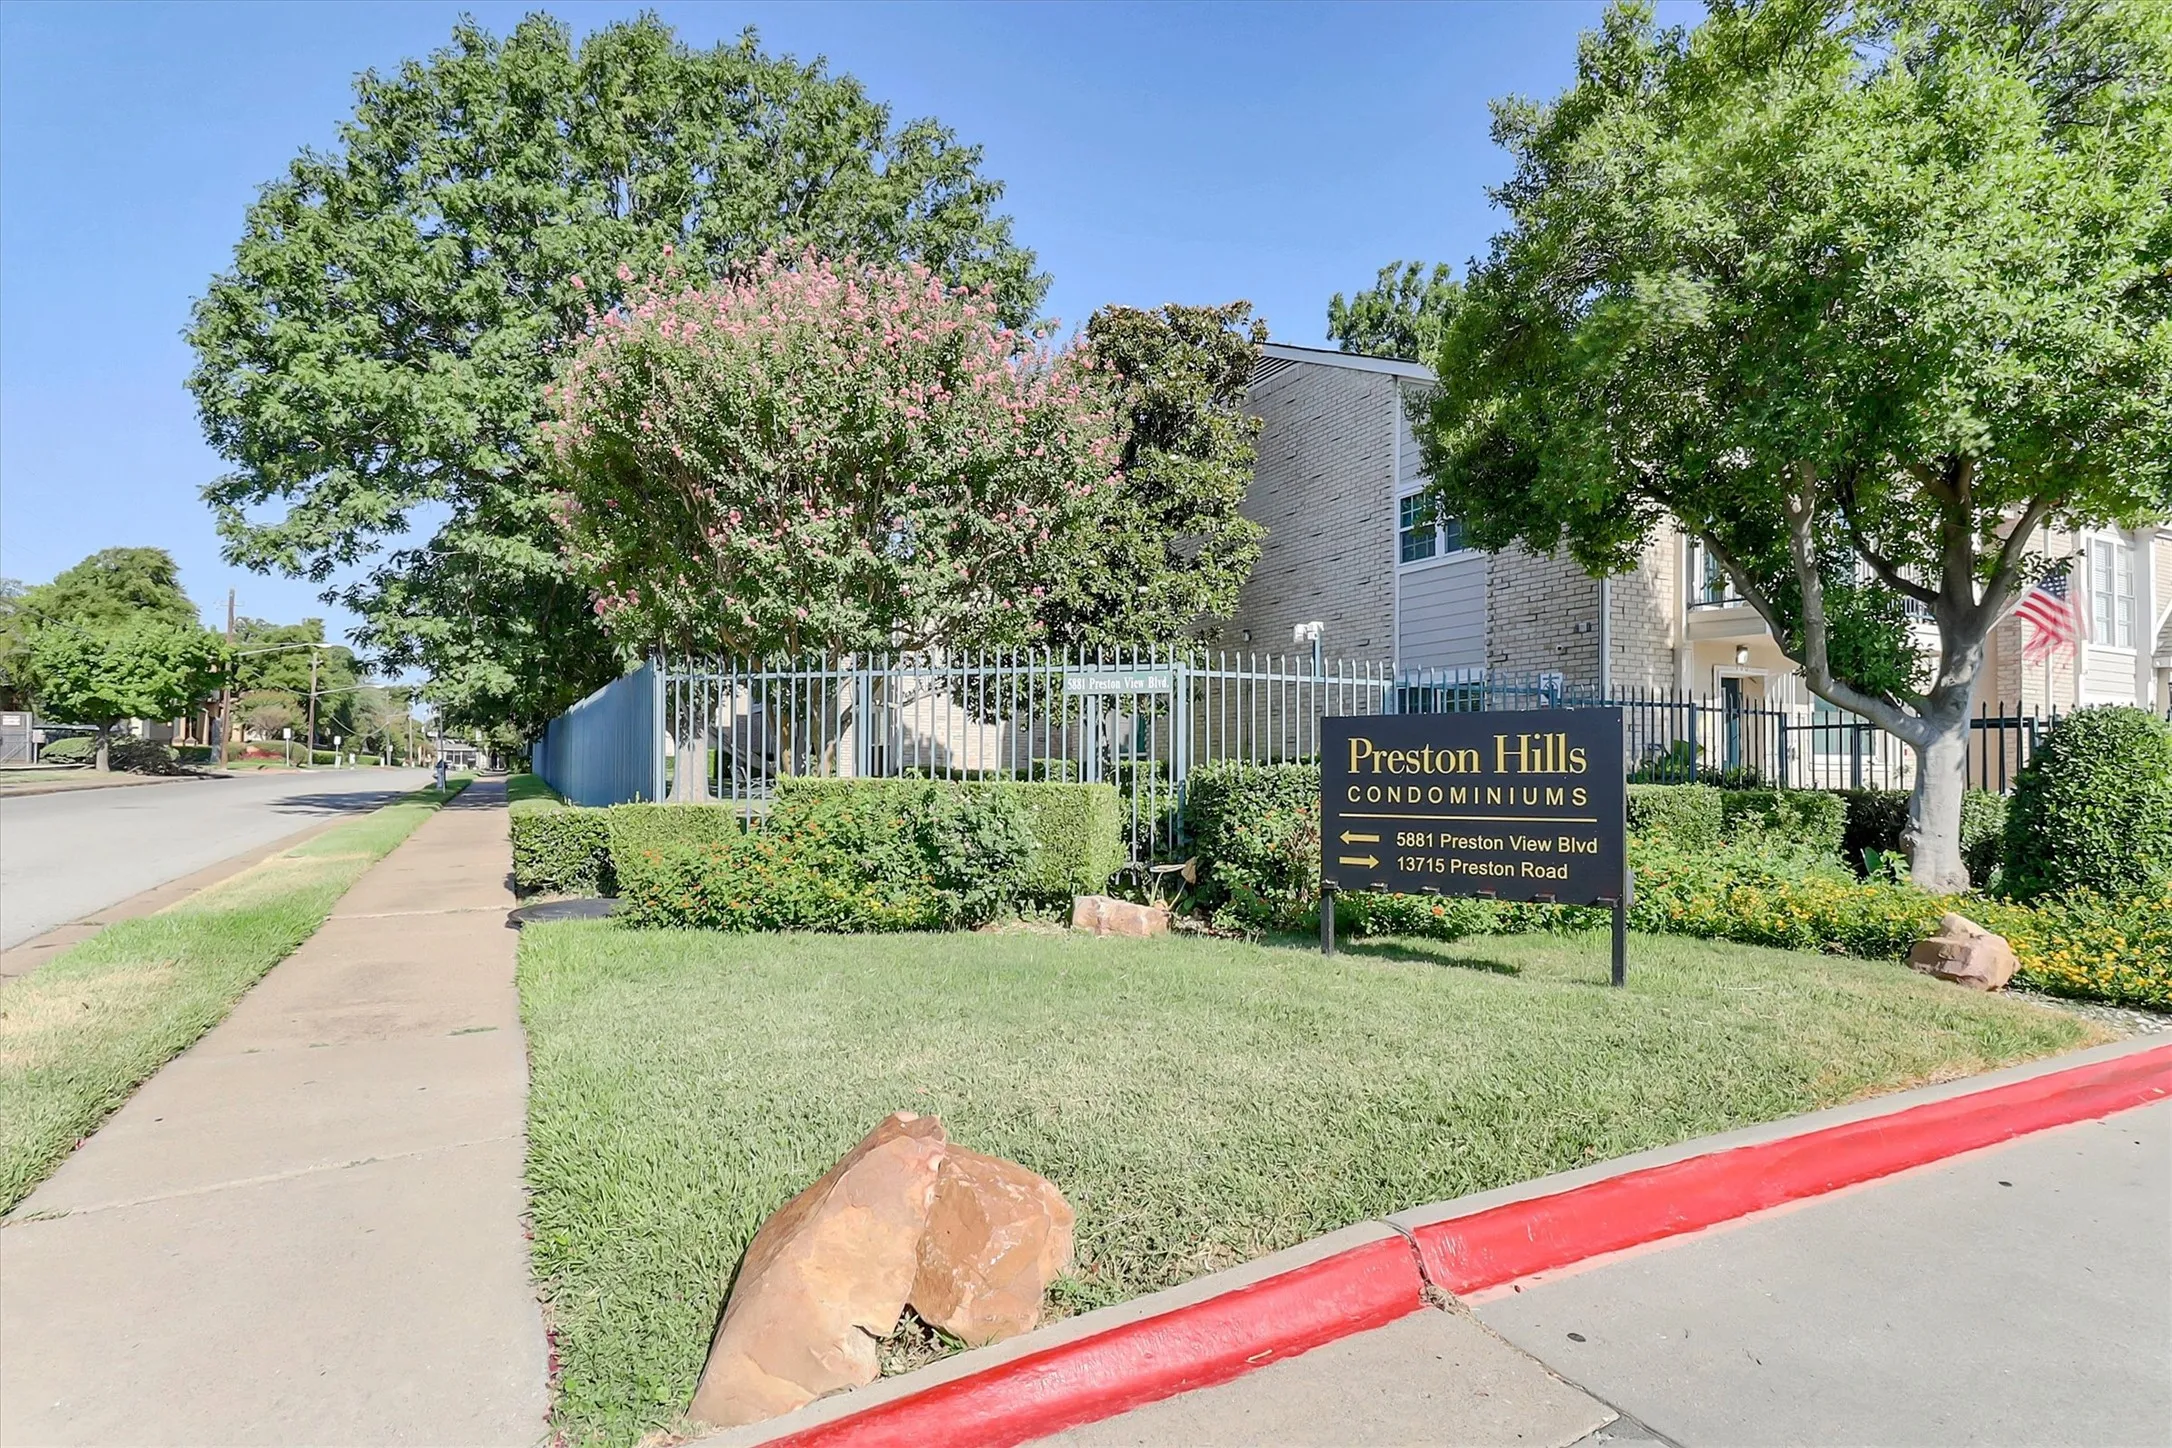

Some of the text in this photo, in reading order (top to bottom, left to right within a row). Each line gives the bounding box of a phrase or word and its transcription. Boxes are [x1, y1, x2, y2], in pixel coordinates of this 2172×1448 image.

[1067, 675, 1170, 690] 5881 Preston View Blvd.
[1347, 732, 1588, 775] Preston Hills
[1347, 785, 1588, 807] CONDOMINIUMS
[1396, 832, 1598, 854] 5881 Preston View Blvd
[1397, 856, 1568, 880] 13715 Preston Road
